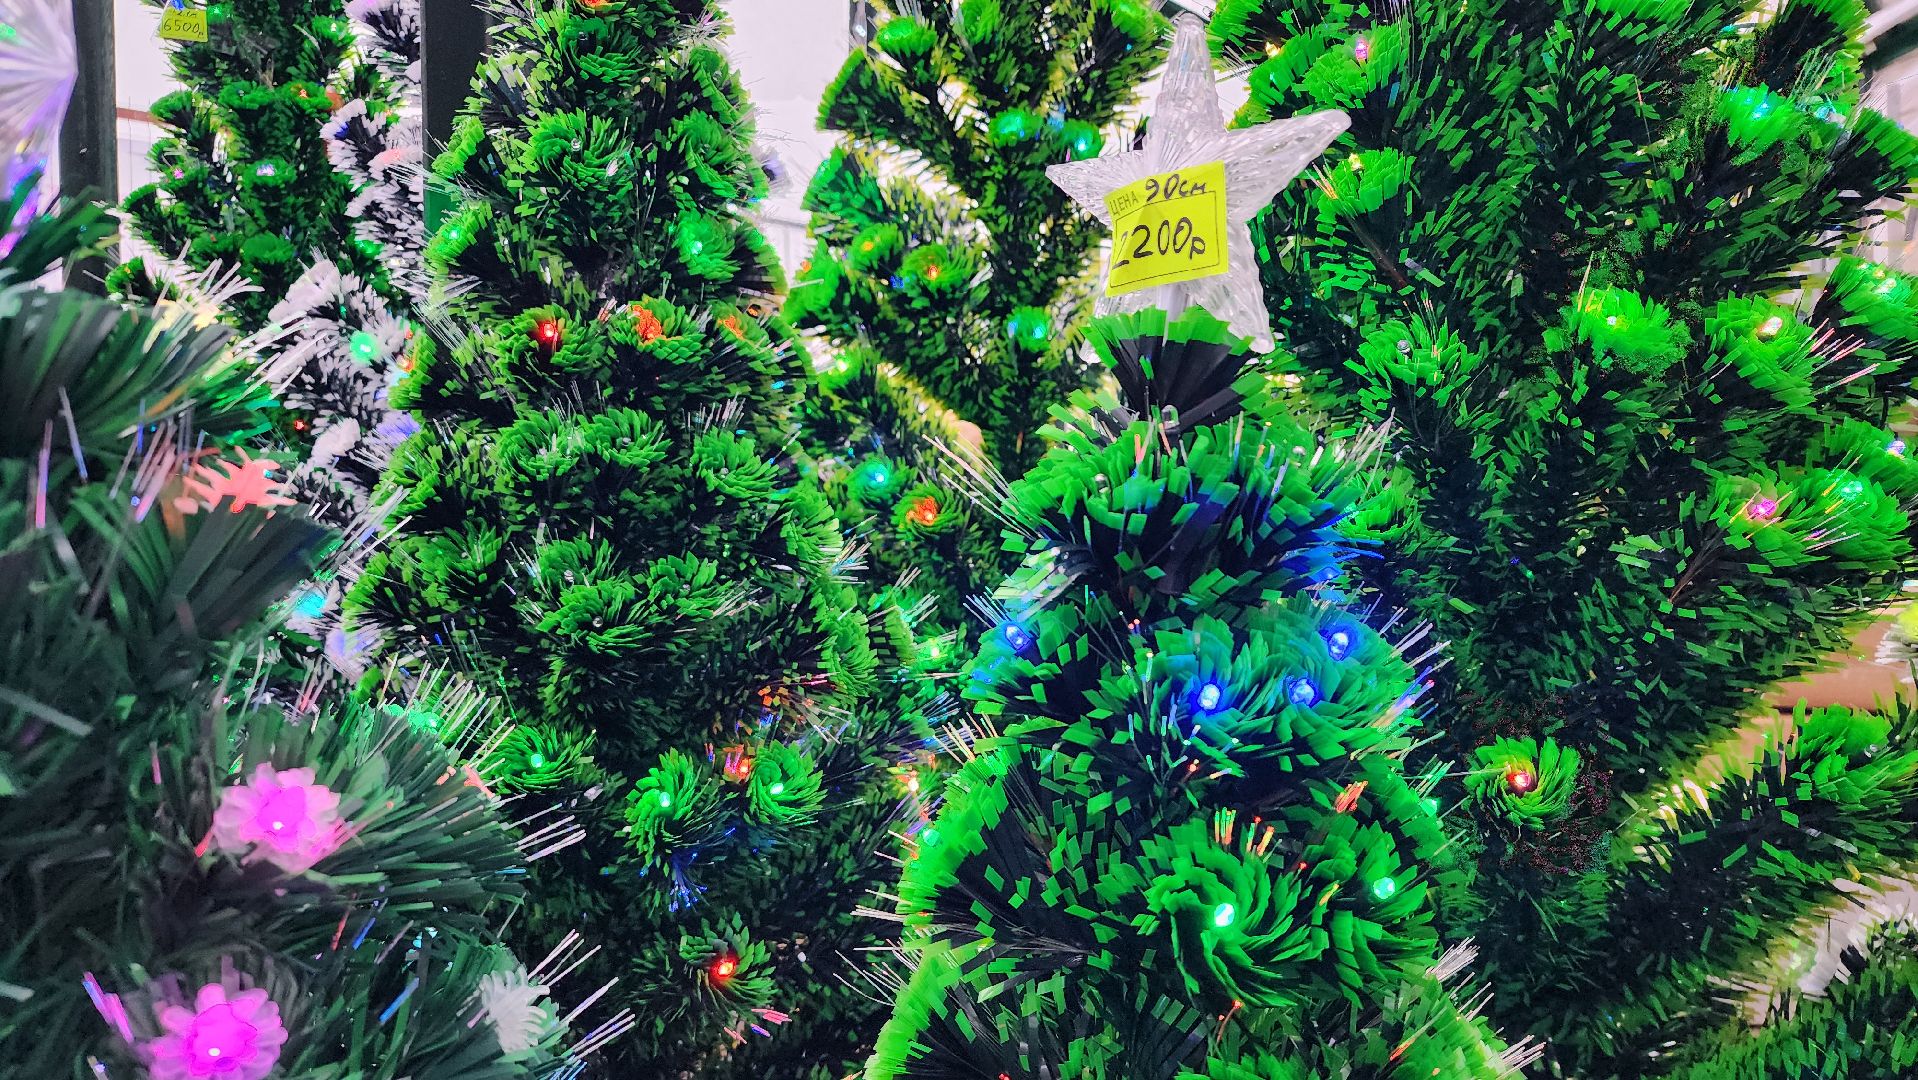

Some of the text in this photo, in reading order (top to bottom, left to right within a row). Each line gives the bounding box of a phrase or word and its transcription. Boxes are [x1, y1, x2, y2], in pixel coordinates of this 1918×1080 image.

[1110, 174, 1206, 215] ЦЕНА 90см
[1112, 217, 1206, 270] 2200р
